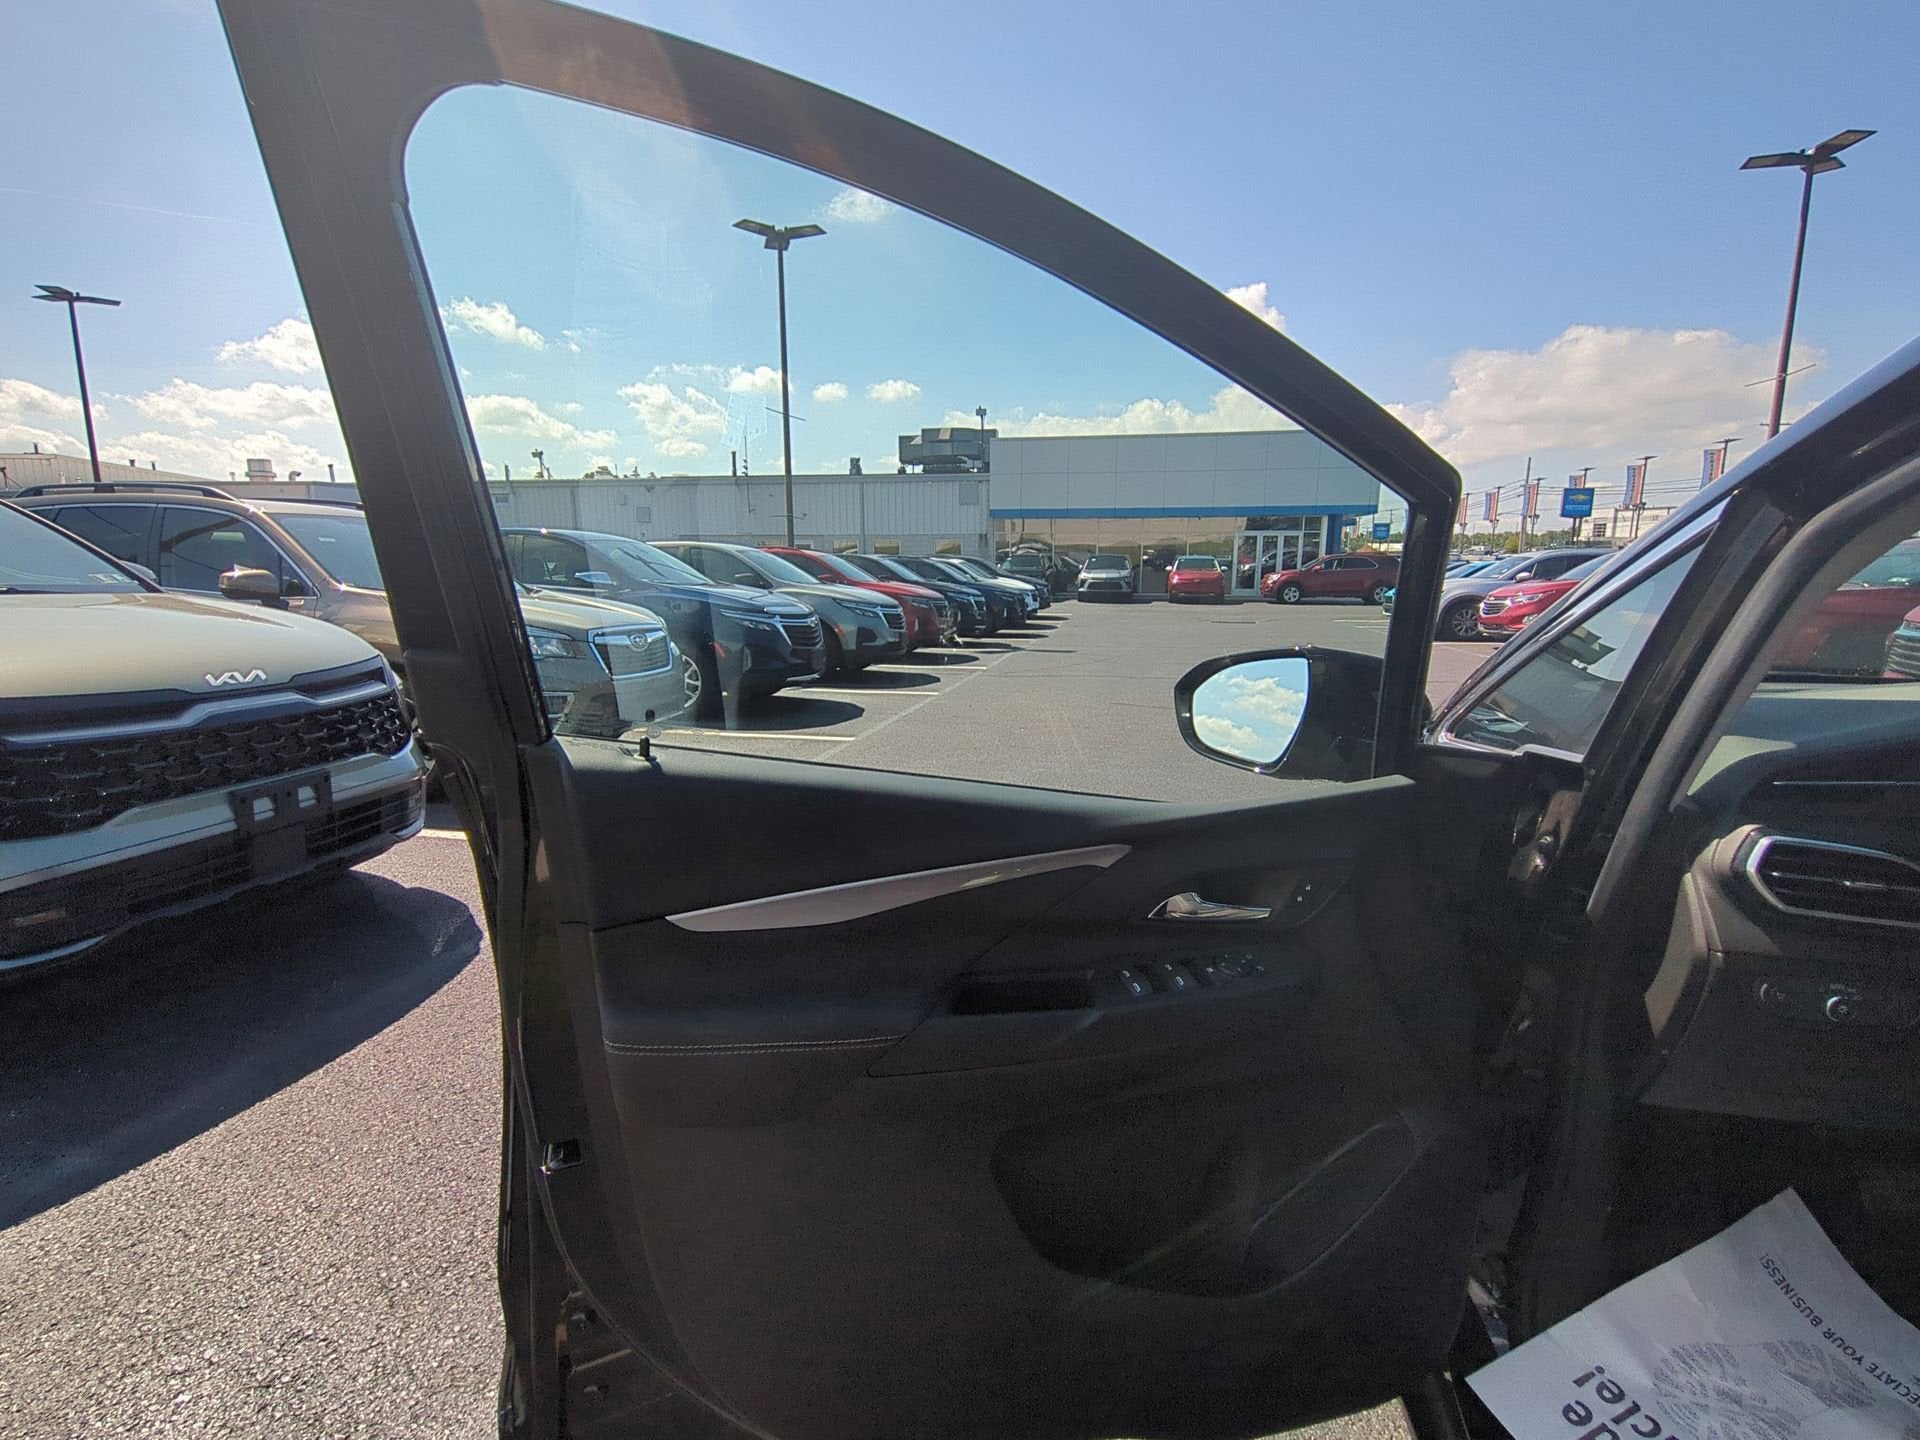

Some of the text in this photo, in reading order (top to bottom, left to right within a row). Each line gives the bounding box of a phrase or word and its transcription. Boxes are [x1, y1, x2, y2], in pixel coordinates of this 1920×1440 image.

[1759, 1254, 1920, 1409] ECIATE YOUR BUSINESS!
